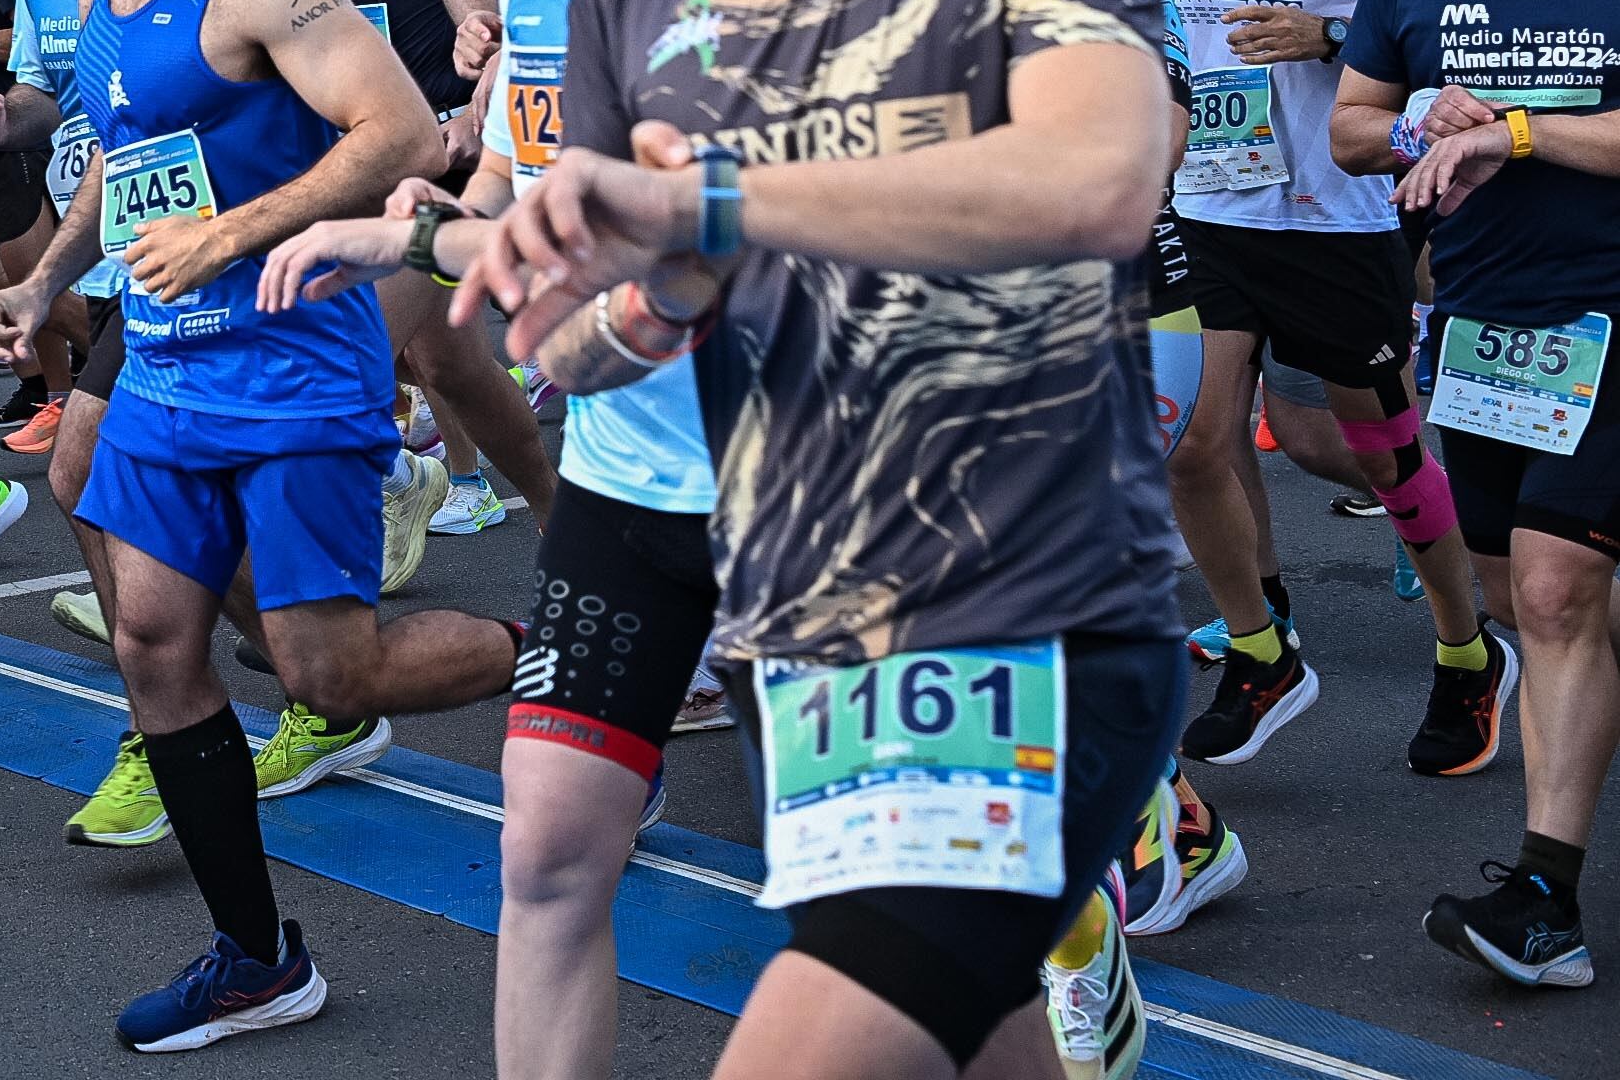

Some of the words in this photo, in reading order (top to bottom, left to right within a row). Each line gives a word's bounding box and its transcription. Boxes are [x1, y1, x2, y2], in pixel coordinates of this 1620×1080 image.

[40, 16, 80, 33] Medio
[40, 34, 79, 55] Alme
[1440, 28, 1503, 47] Medio
[1512, 27, 1605, 45] Maratón
[1442, 46, 1534, 70] Almería
[1444, 73, 1492, 86] RAMÓN
[1497, 74, 1532, 86] RUIZ
[1535, 73, 1604, 86] ANDÚJAR
[514, 88, 564, 144] 12
[1188, 91, 1248, 133] 580
[114, 164, 198, 226] 2445
[1474, 322, 1573, 377] 585
[1496, 365, 1523, 379] DIEGO
[798, 659, 1014, 757] 1161
